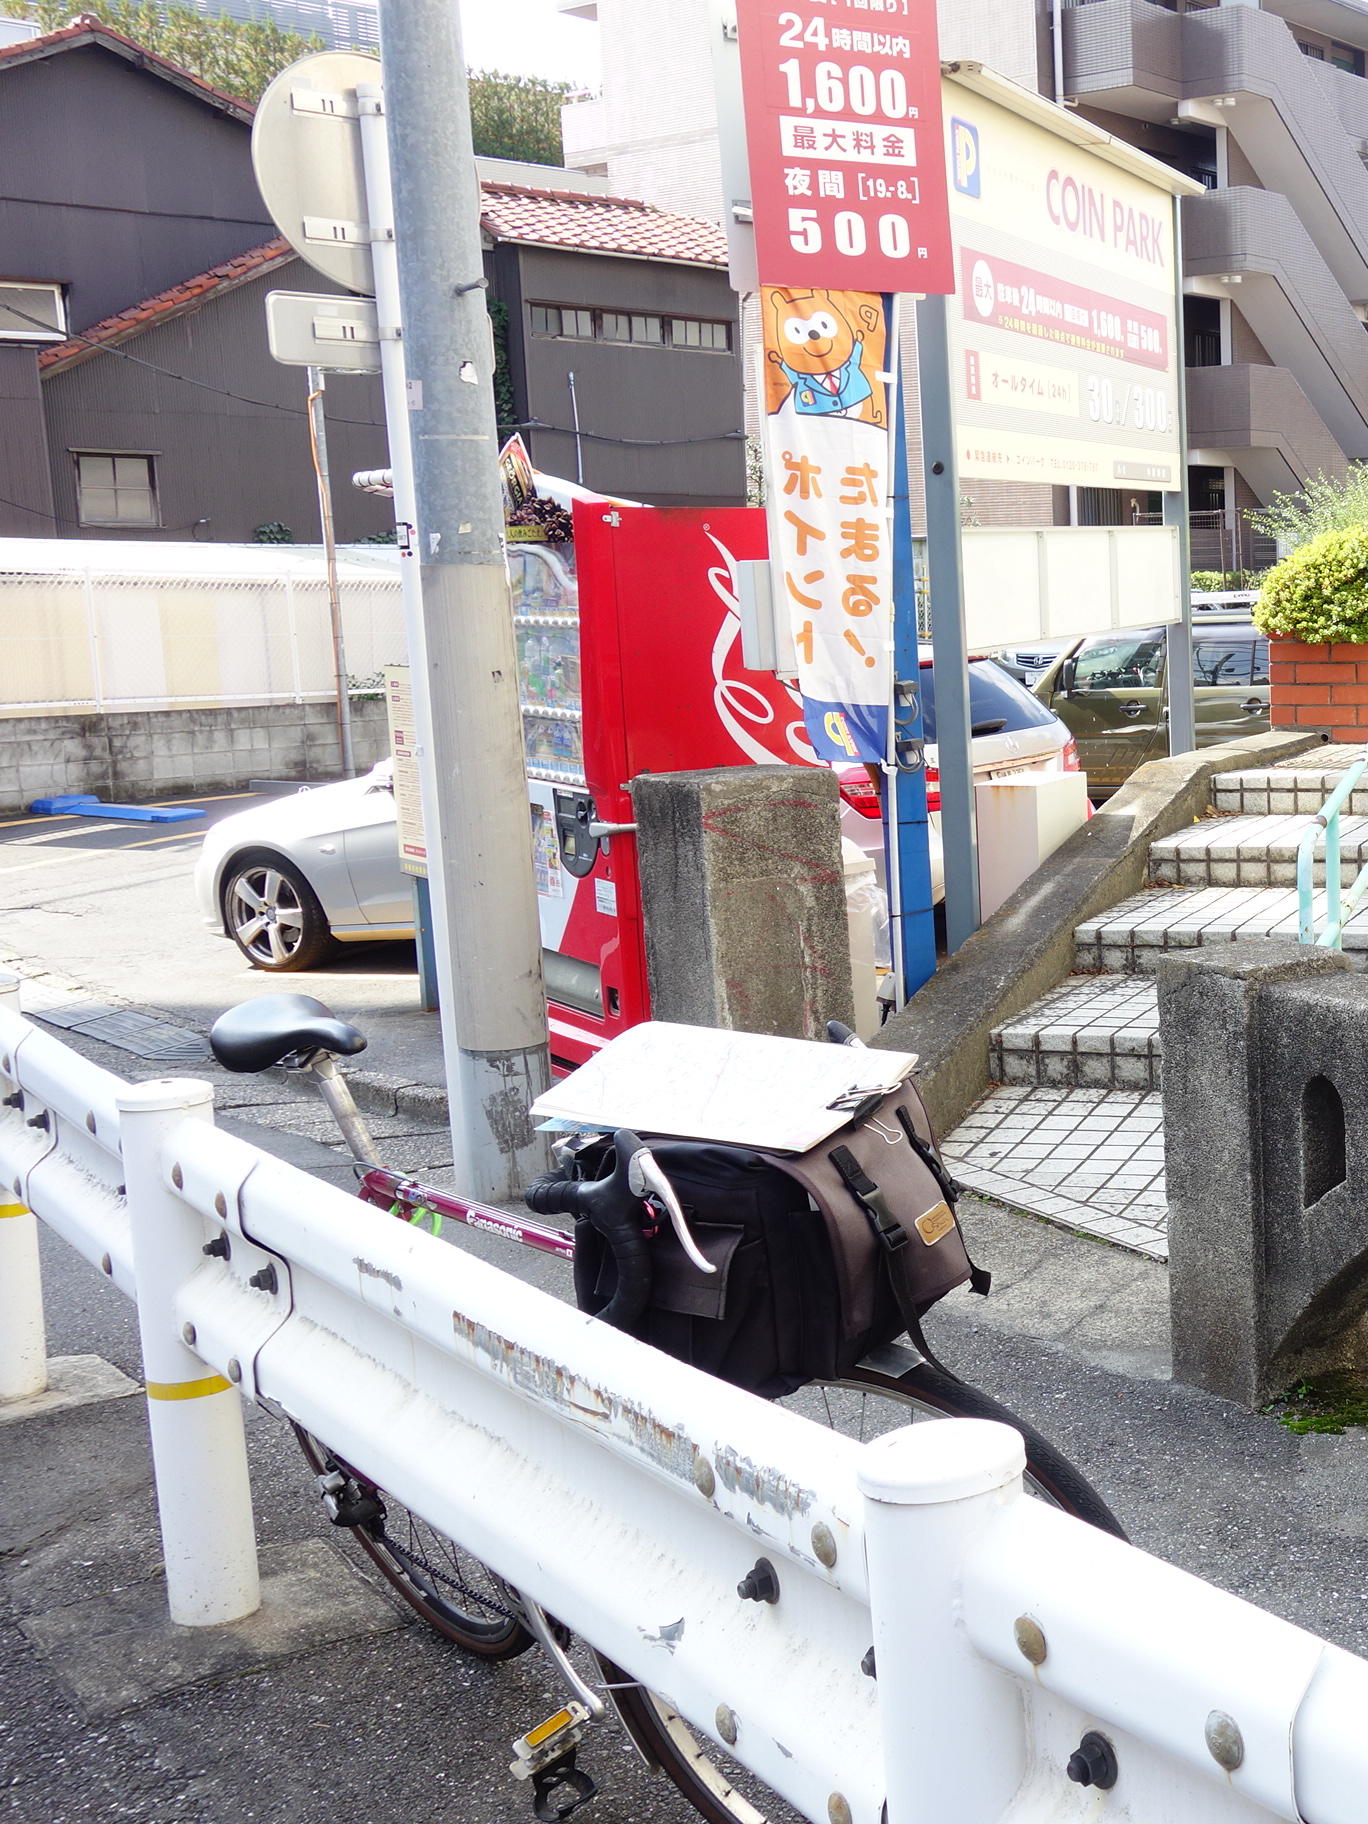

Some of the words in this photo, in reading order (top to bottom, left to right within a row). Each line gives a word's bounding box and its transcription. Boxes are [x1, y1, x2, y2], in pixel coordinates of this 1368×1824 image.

[778, 12, 911, 59] 24時間以内
[778, 58, 919, 120] 1,600円
[792, 125, 906, 159] 最大料金
[783, 167, 845, 199] 夜間
[787, 207, 928, 259] 500円
[1045, 168, 1106, 243] COIN
[1112, 199, 1165, 269] PARK
[991, 369, 1044, 397] オールタイム
[466, 1209, 523, 1242] Panasonic
